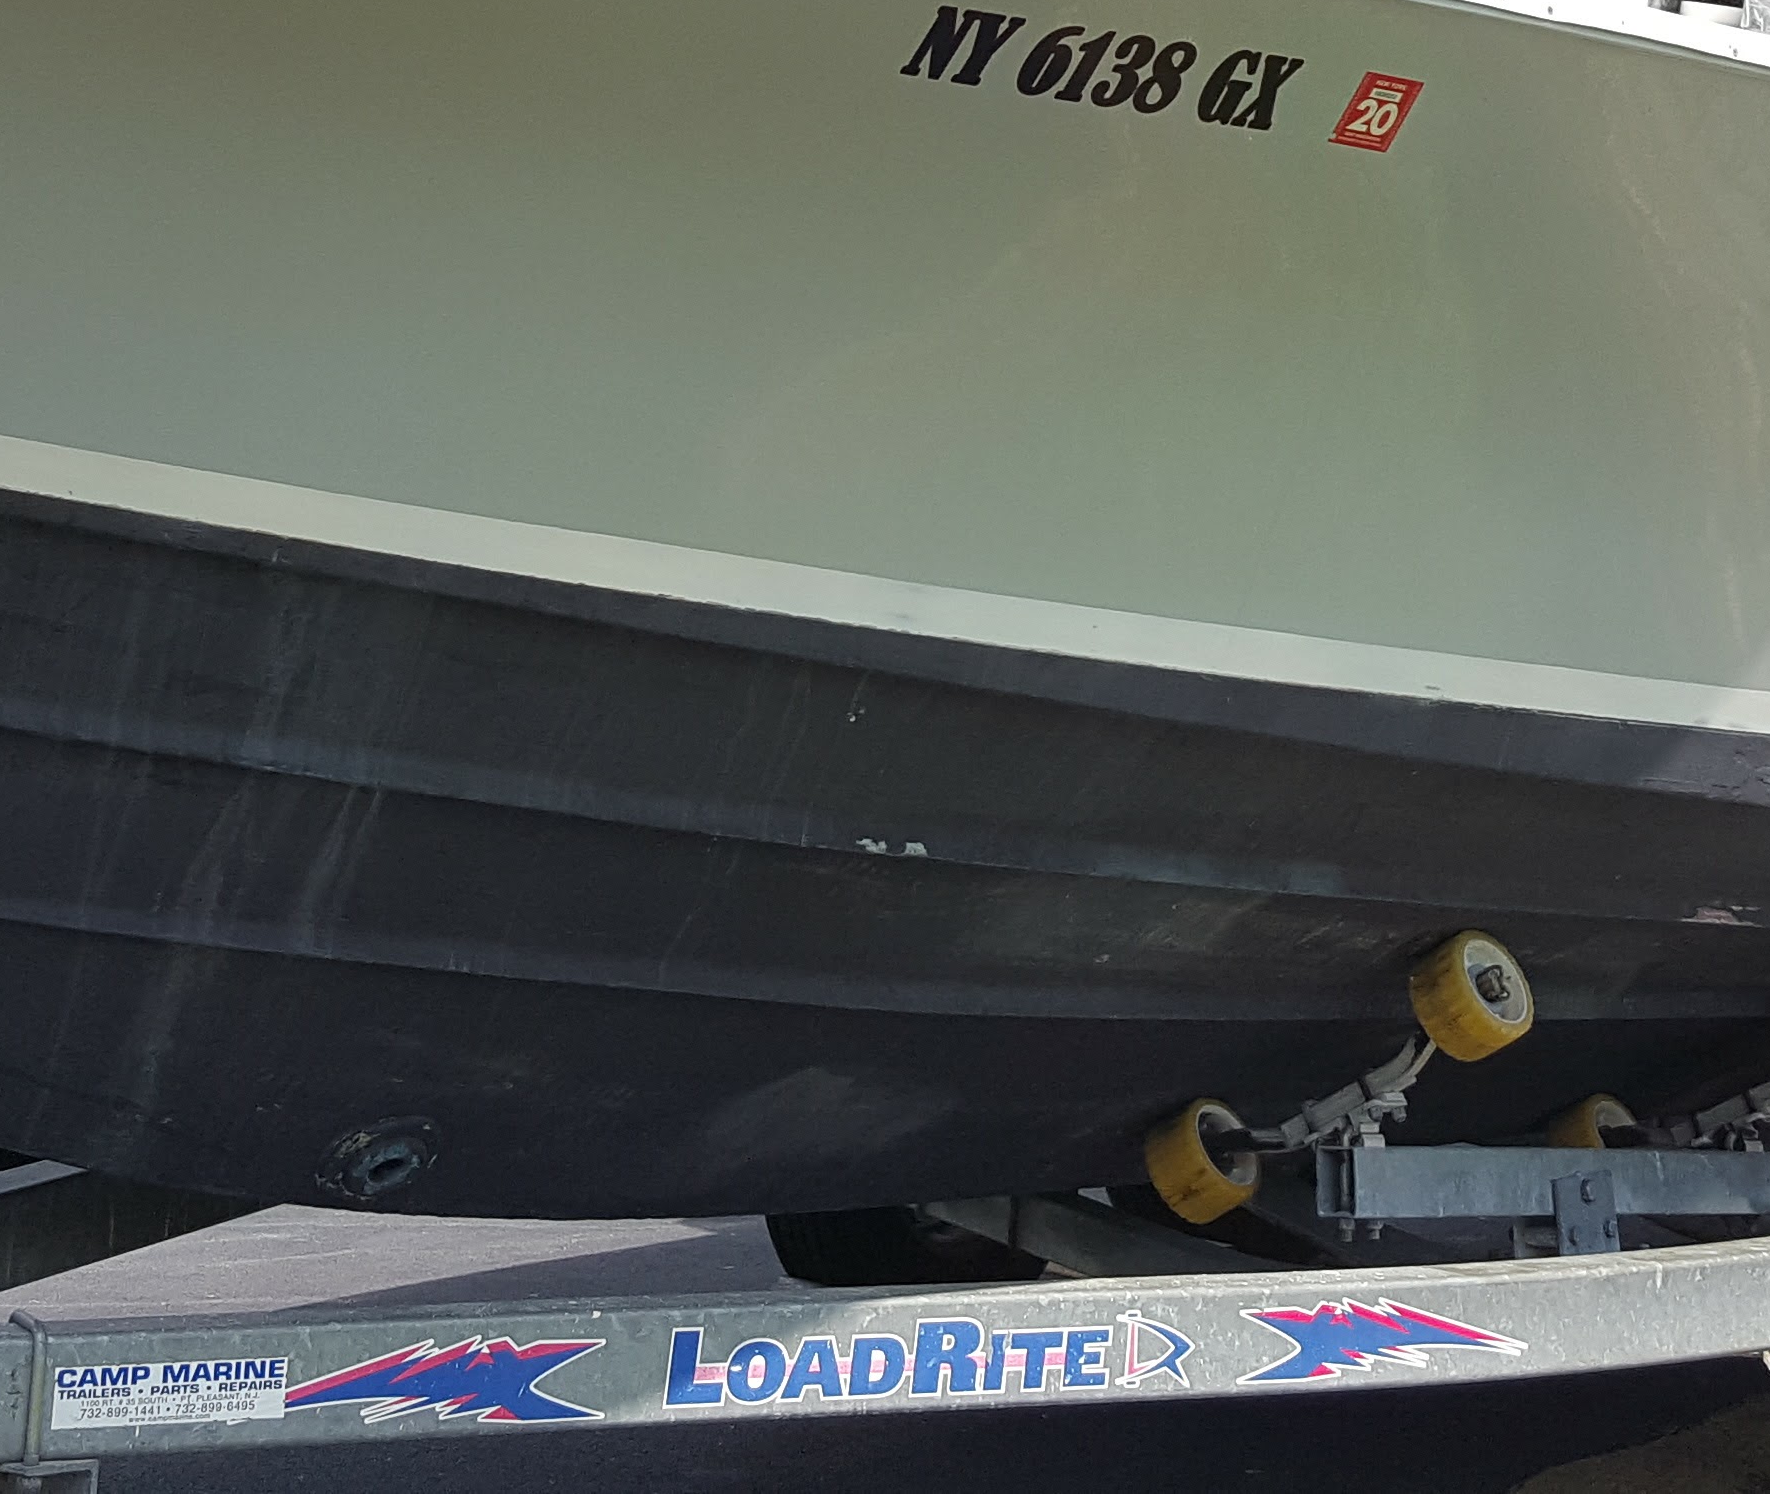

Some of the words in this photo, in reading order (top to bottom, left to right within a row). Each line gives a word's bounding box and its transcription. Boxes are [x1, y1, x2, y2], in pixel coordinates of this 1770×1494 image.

[900, 5, 1026, 86] NY
[1016, 25, 1197, 114] 6138
[1197, 49, 1304, 131] GX
[1344, 98, 1399, 136] 20
[57, 1366, 151, 1388] CAMP
[162, 1359, 285, 1384] MARINE
[58, 1387, 131, 1400] TRAILERS
[151, 1383, 200, 1396] PARTS
[218, 1379, 283, 1393] REPAIRS
[137, 1395, 167, 1404] SOUTH
[79, 1405, 160, 1420] 732-899-1441
[175, 1399, 255, 1414] 732-899-6495
